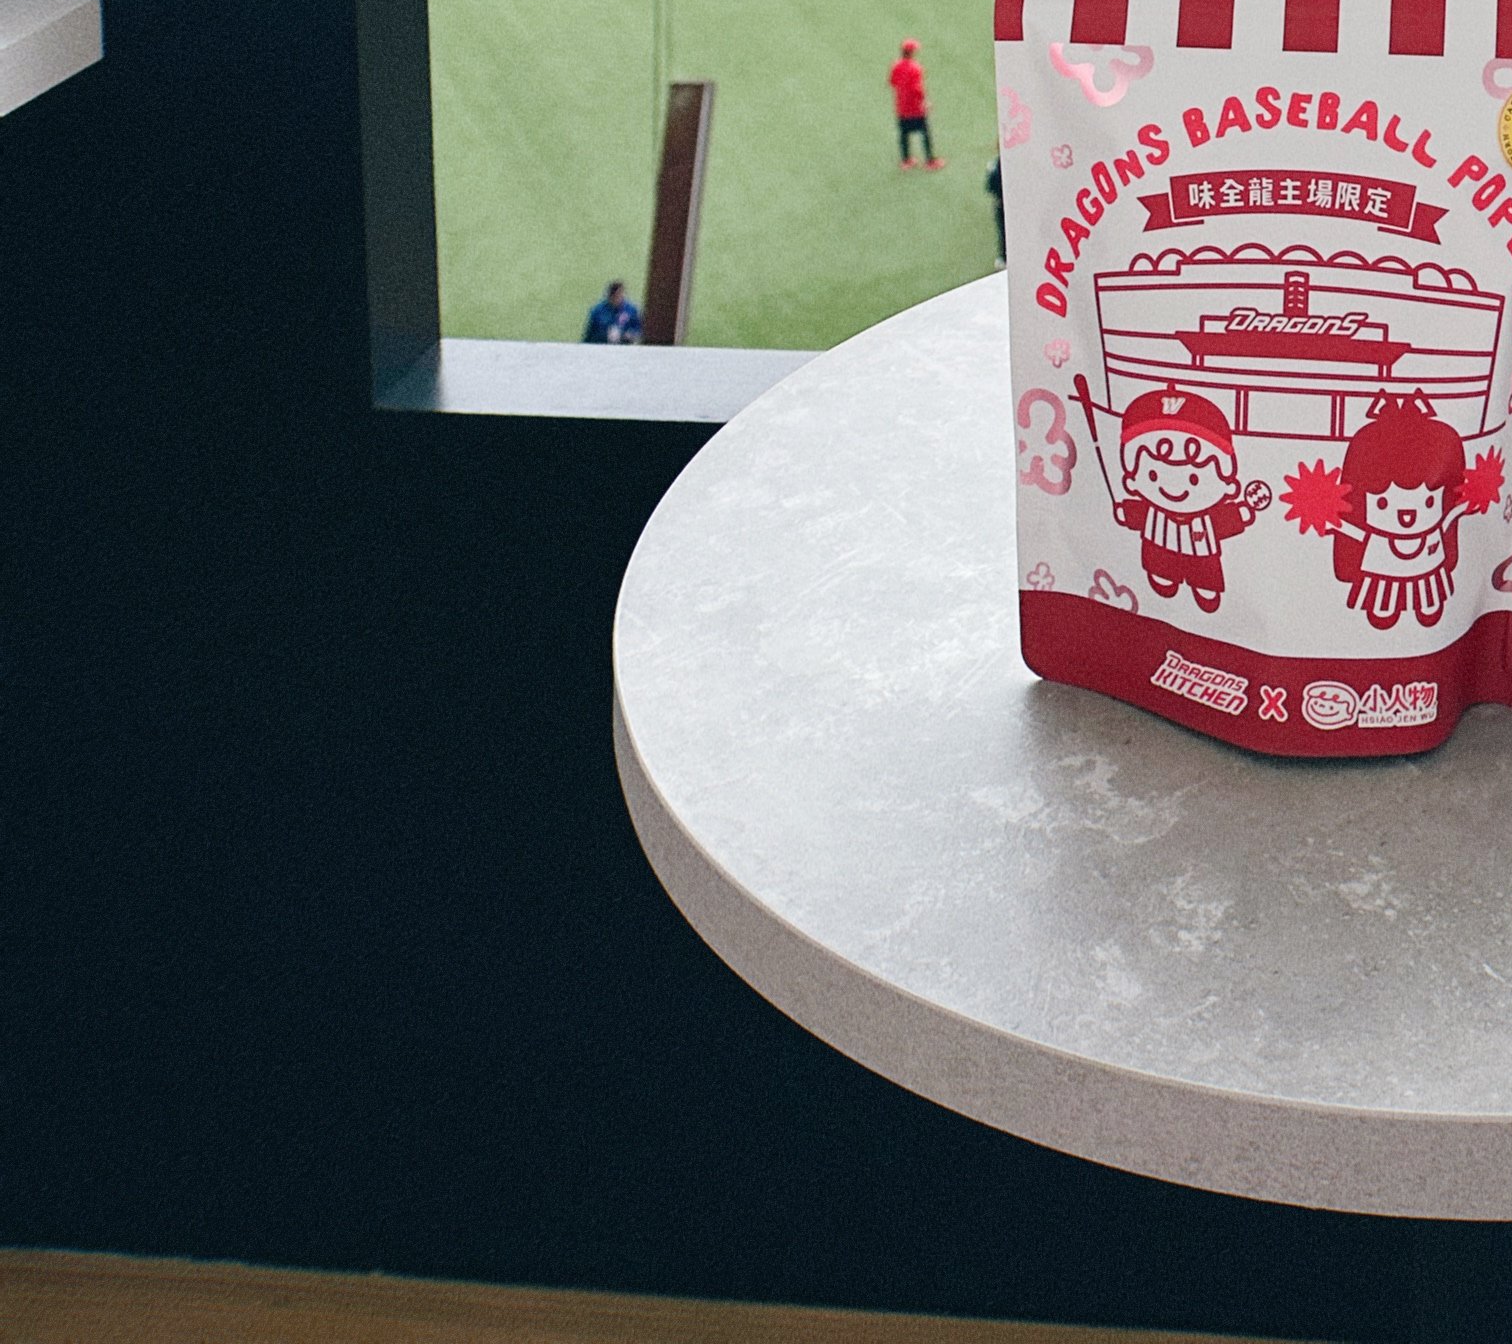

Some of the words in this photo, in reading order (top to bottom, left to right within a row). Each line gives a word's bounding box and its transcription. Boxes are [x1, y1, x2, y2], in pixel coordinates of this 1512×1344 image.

[1036, 124, 1170, 318] DRAGONS
[1182, 86, 1437, 169] BASEBALL
[1188, 177, 1392, 218] 味全龍主場限定
[1227, 309, 1367, 336] DRAGONS
[1161, 396, 1186, 415] W
[1167, 652, 1246, 691] DRAGONS
[1154, 669, 1247, 712] KITCHEN
[1361, 683, 1437, 713] 小人物
[1361, 715, 1394, 725] HSIAO
